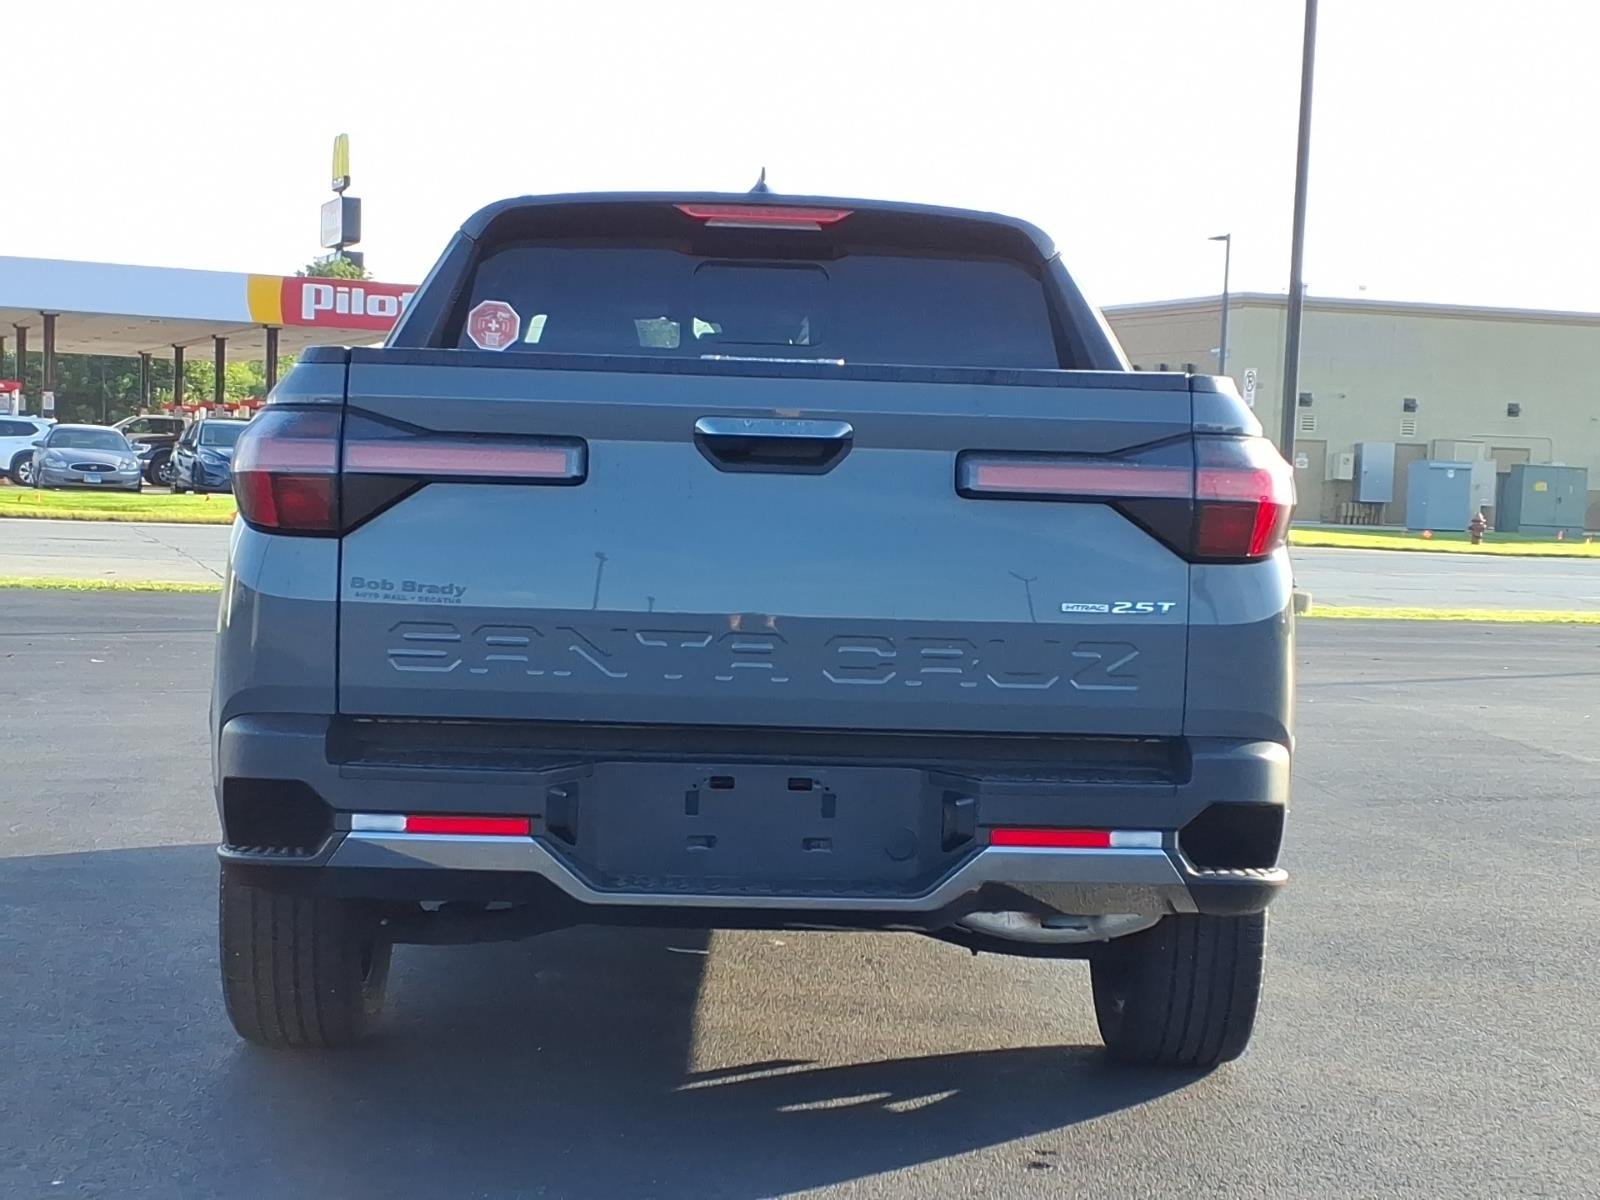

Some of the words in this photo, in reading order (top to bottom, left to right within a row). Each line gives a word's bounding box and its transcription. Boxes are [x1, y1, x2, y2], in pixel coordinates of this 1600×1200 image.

[350, 577, 394, 590] Bob
[401, 580, 466, 597] Brady
[1064, 603, 1107, 612] HTRAC
[387, 620, 788, 683] SANTA
[822, 634, 1140, 691] CRUZ
